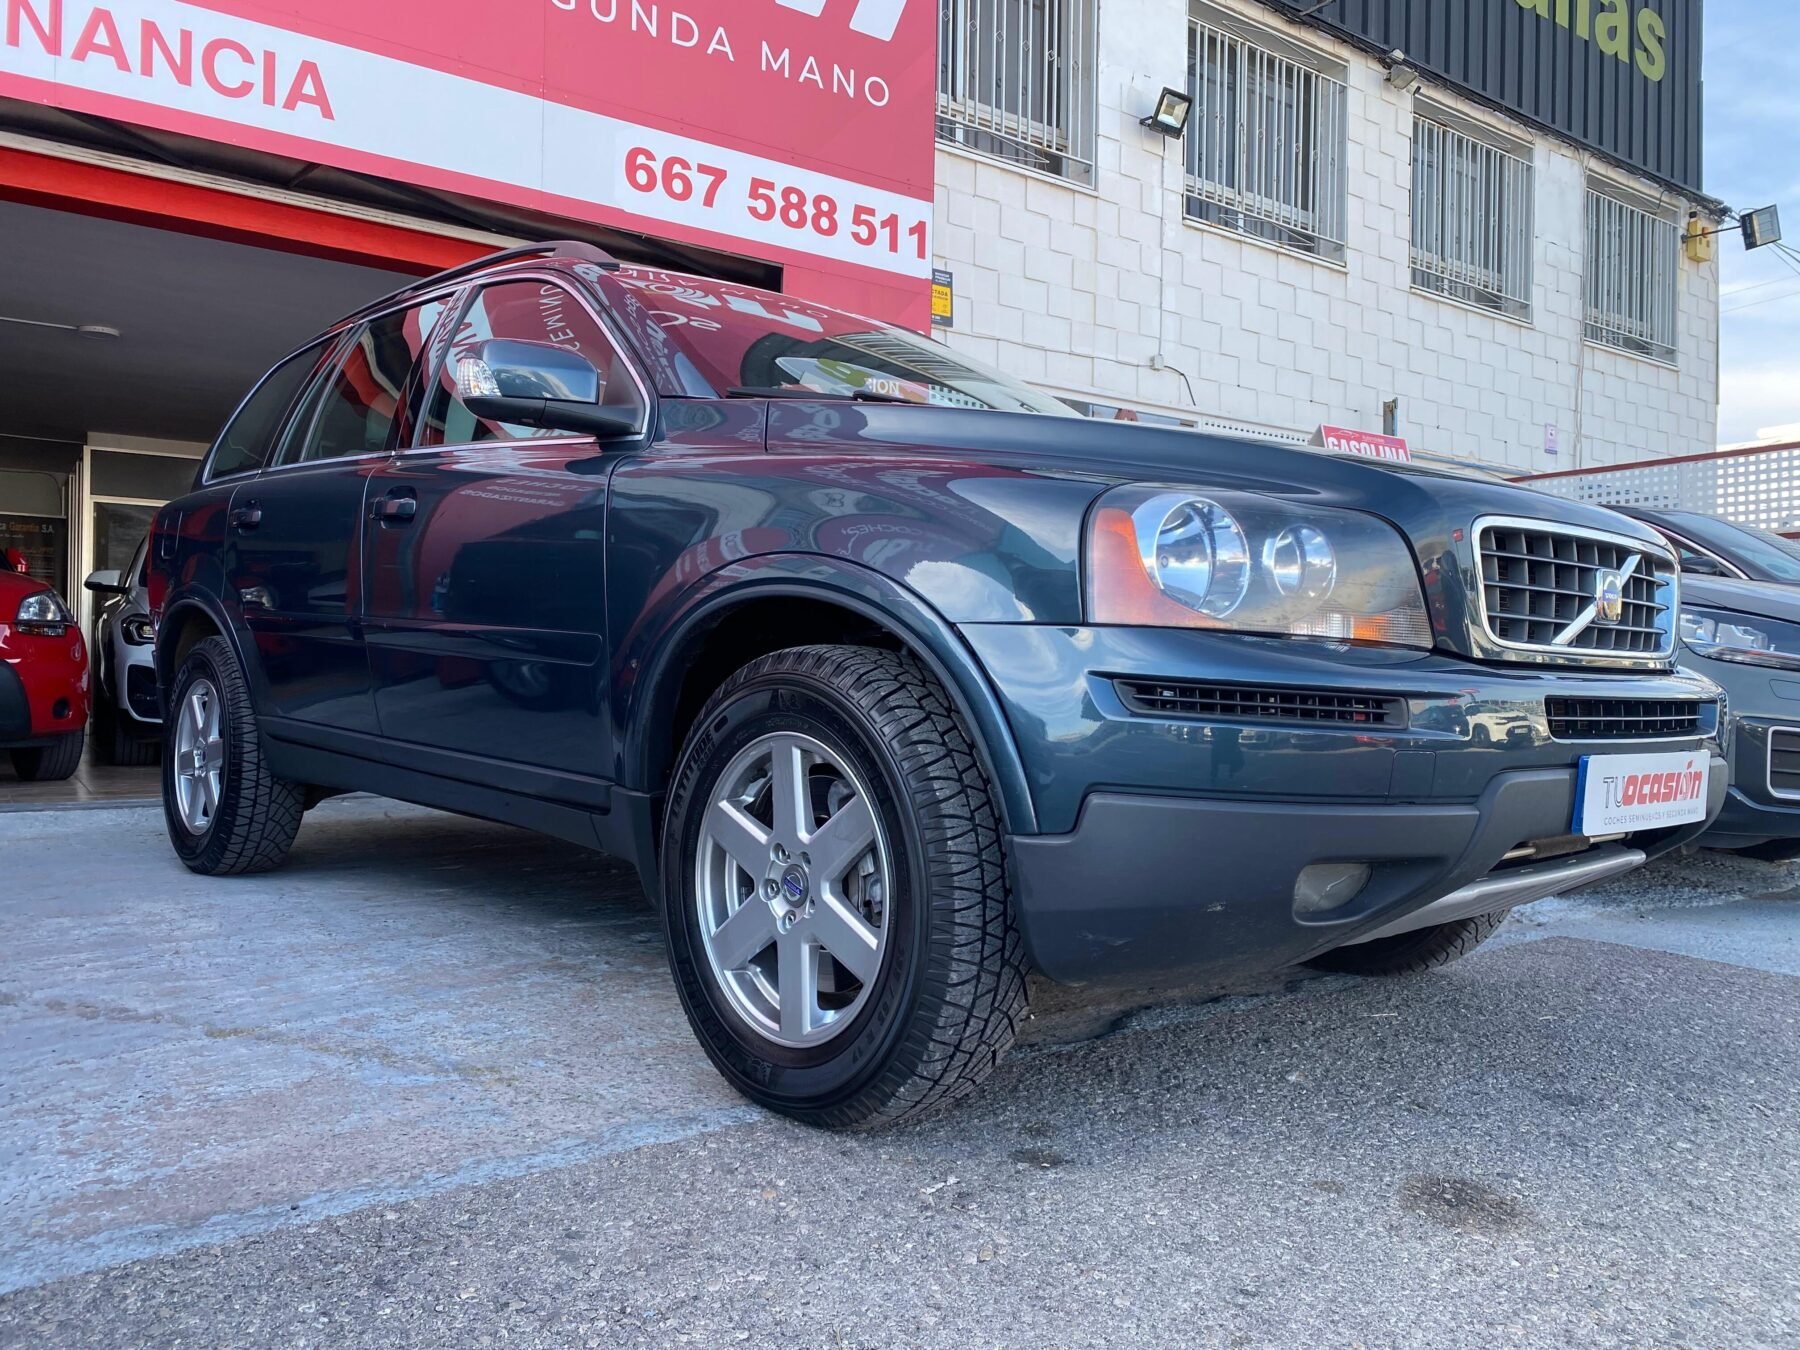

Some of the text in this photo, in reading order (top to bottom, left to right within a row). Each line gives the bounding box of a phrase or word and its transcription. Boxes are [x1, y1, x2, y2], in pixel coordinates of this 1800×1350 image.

[760, 41, 890, 107] MANO
[624, 146, 927, 260] 667 588 511
